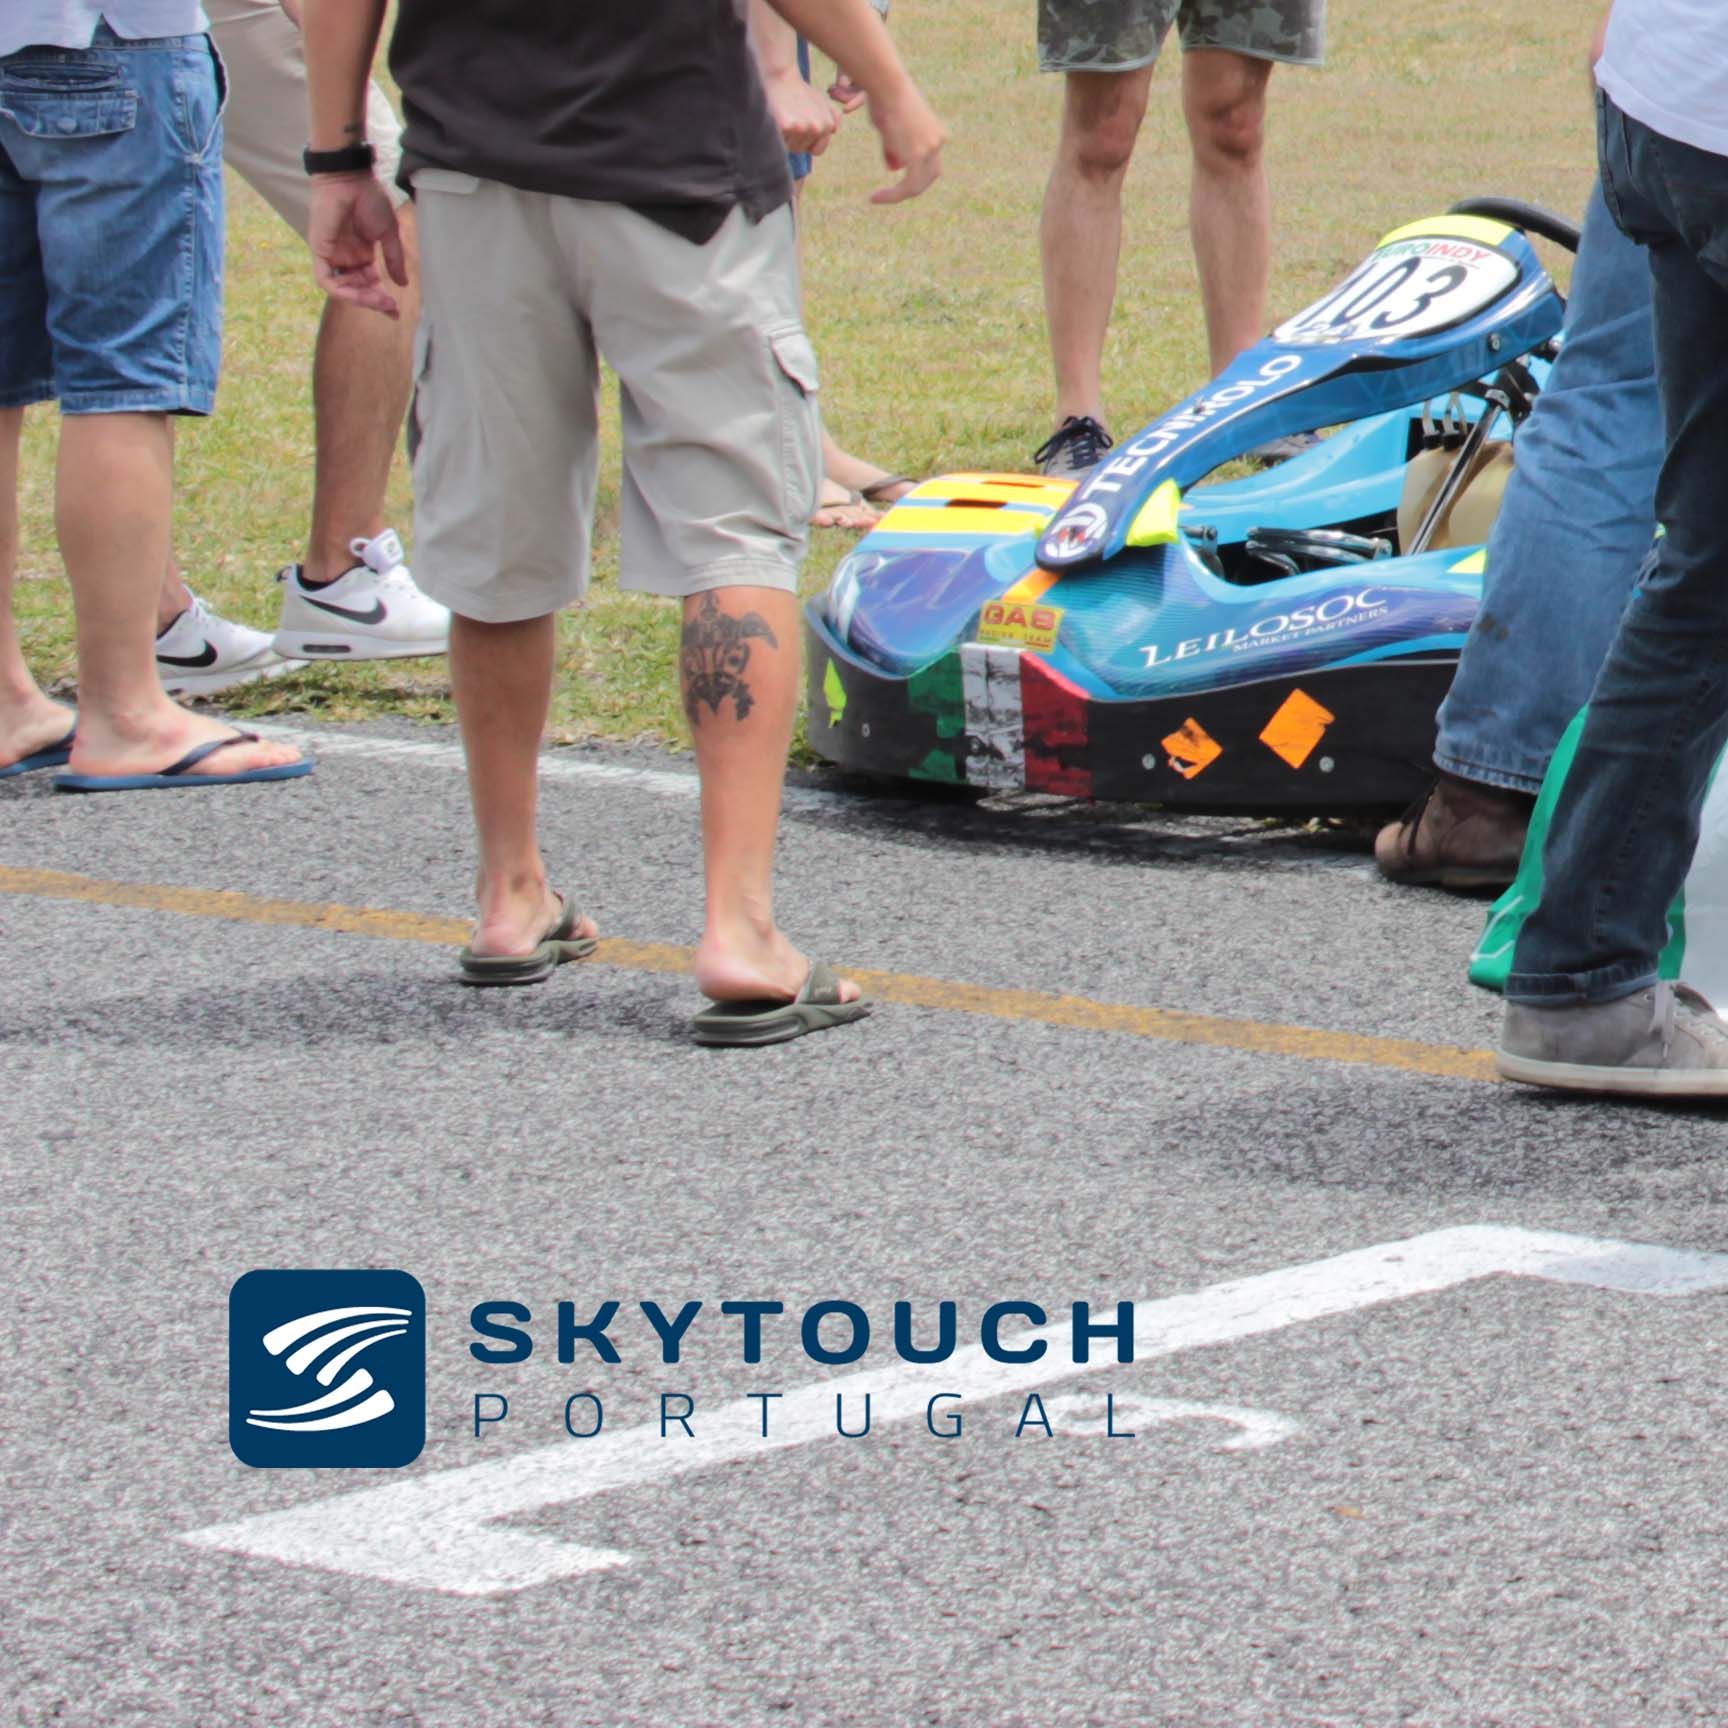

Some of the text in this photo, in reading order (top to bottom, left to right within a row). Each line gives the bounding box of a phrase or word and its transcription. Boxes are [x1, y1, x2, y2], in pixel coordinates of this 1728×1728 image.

[1295, 256, 1469, 330] 103
[1081, 354, 1302, 500] TECNIROLO
[1139, 587, 1388, 669] LEILOSOC
[1234, 605, 1388, 652] MARKET PARTNERS
